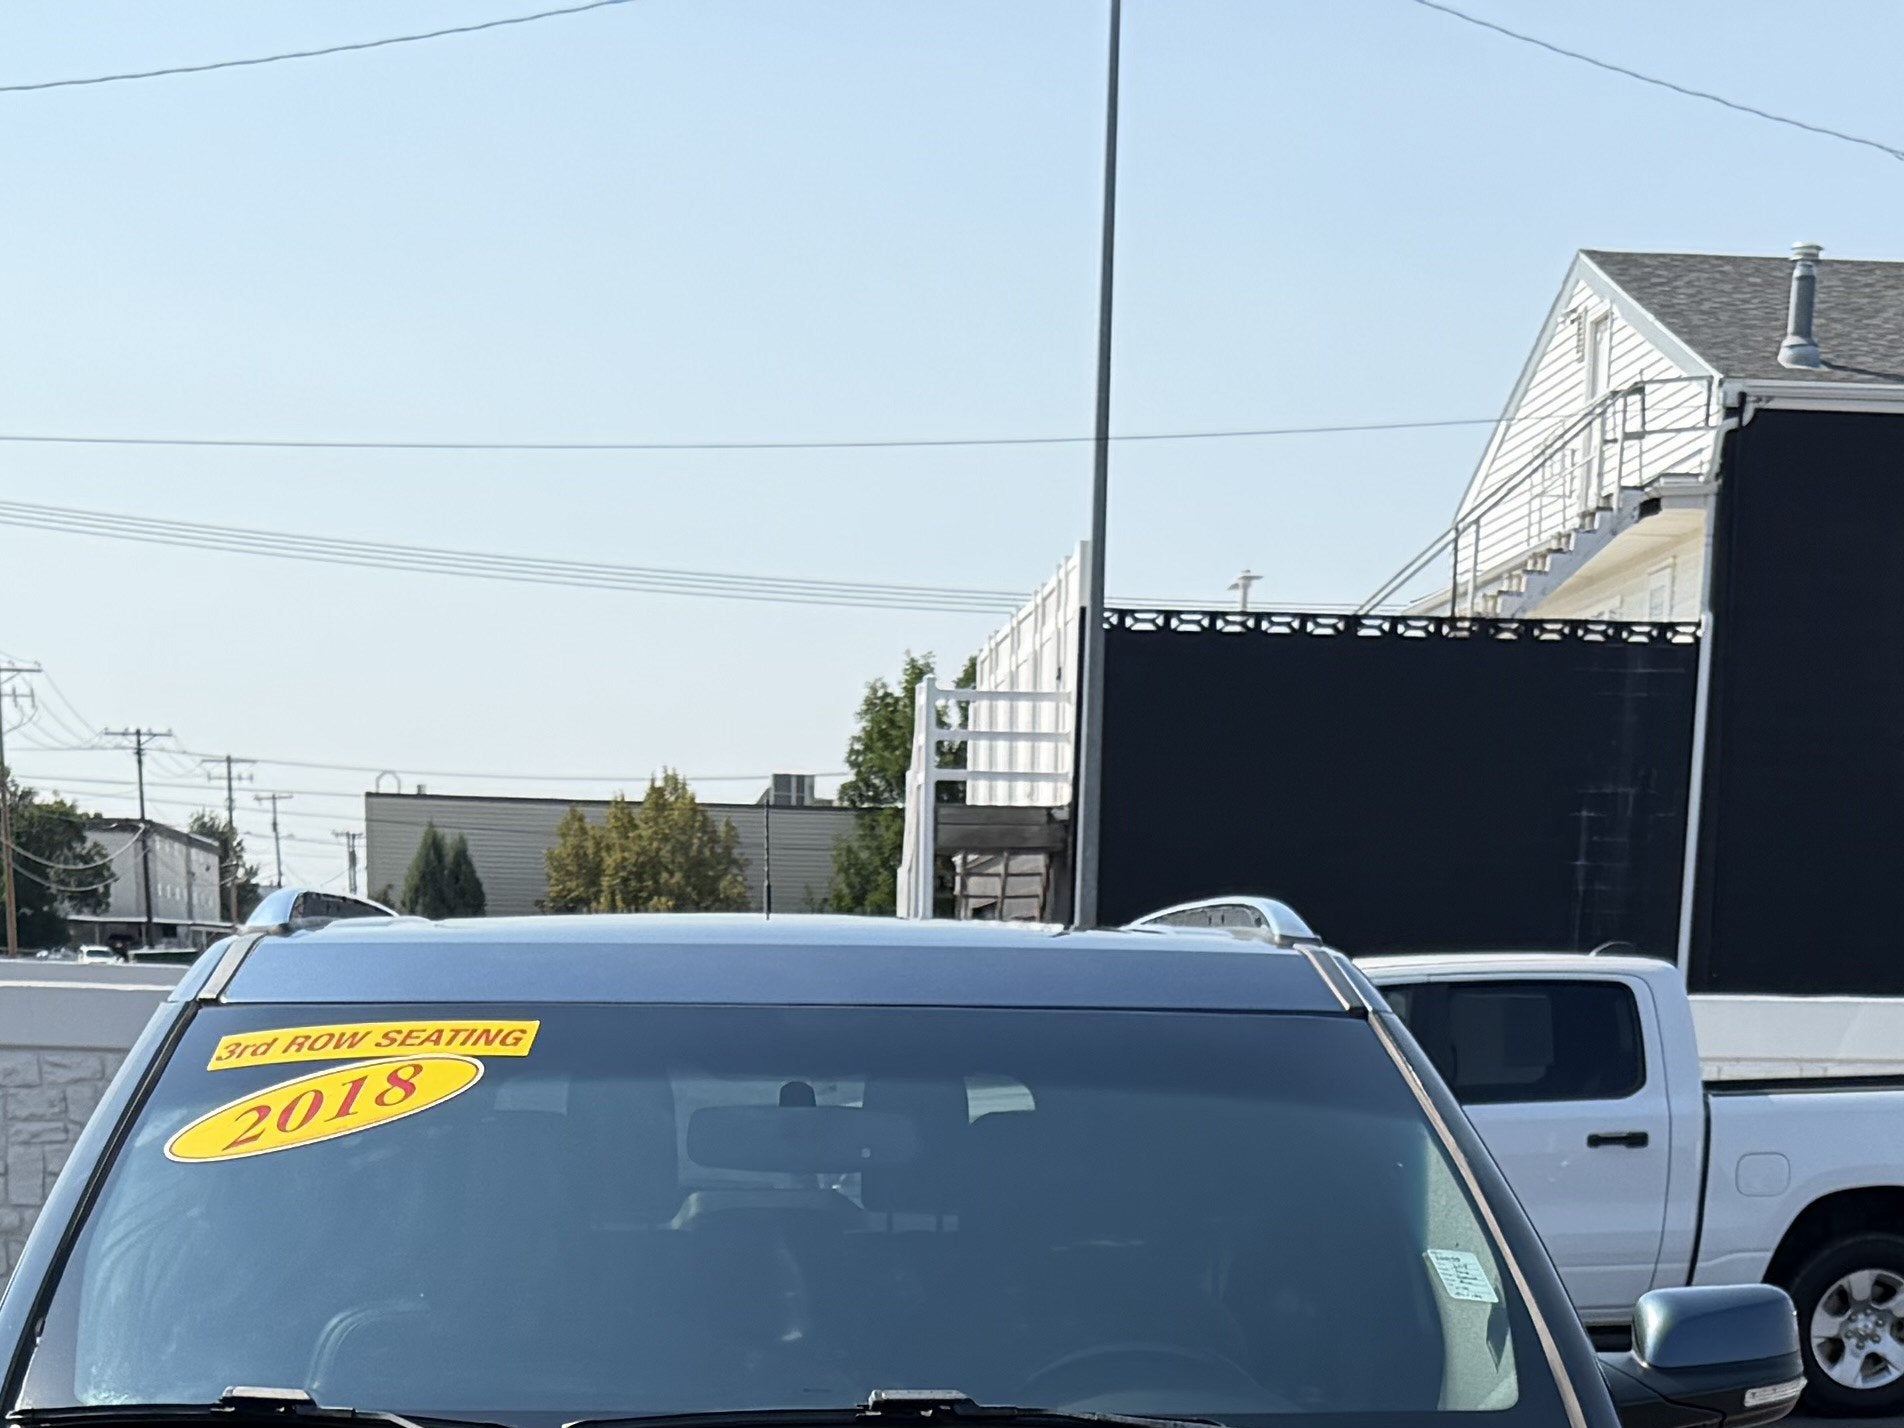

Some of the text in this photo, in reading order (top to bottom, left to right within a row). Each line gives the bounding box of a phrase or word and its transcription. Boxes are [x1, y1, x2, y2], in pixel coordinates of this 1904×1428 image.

[215, 1026, 528, 1062] 3rd ROW SEATING
[221, 1063, 424, 1152] 2018
